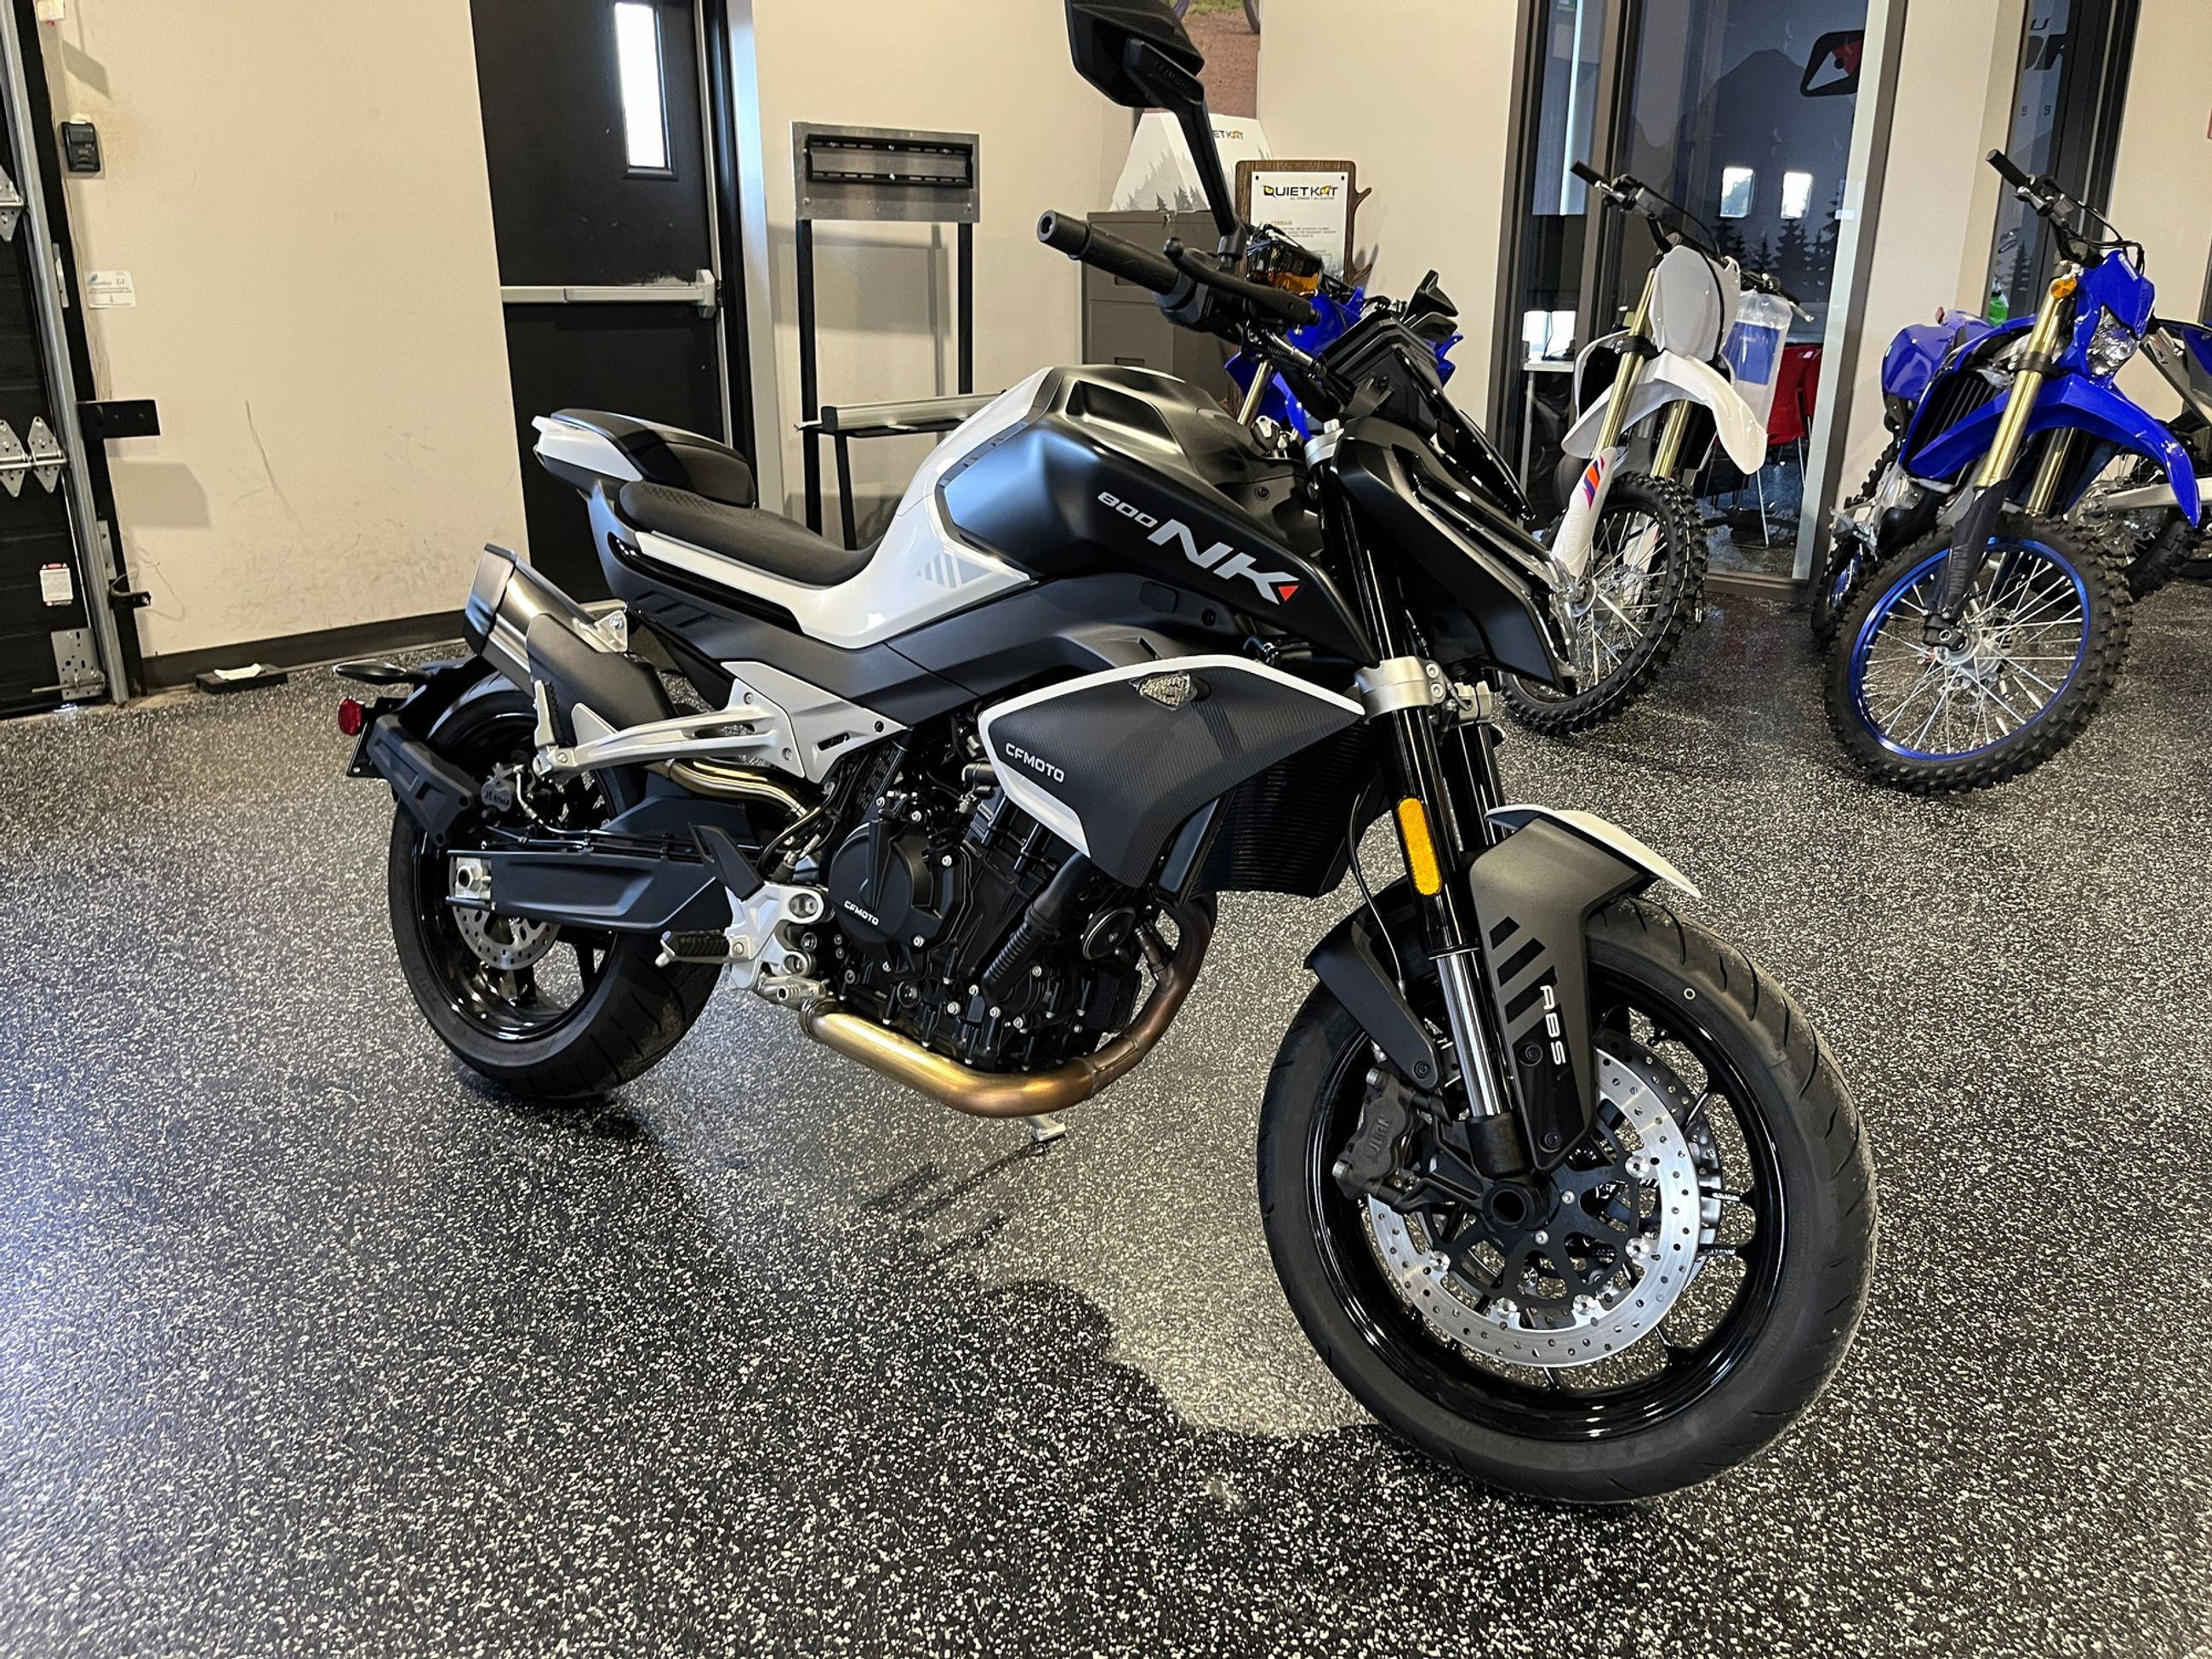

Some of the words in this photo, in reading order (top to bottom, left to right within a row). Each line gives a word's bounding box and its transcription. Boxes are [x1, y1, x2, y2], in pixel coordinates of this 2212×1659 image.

[1212, 130, 1244, 140] ETKAT
[1097, 492, 1158, 527] 800
[1147, 519, 1299, 605] NK
[1006, 743, 1064, 783] CFMOTO
[844, 900, 879, 926] CFMOTO
[1539, 985, 1566, 1065] ABS
